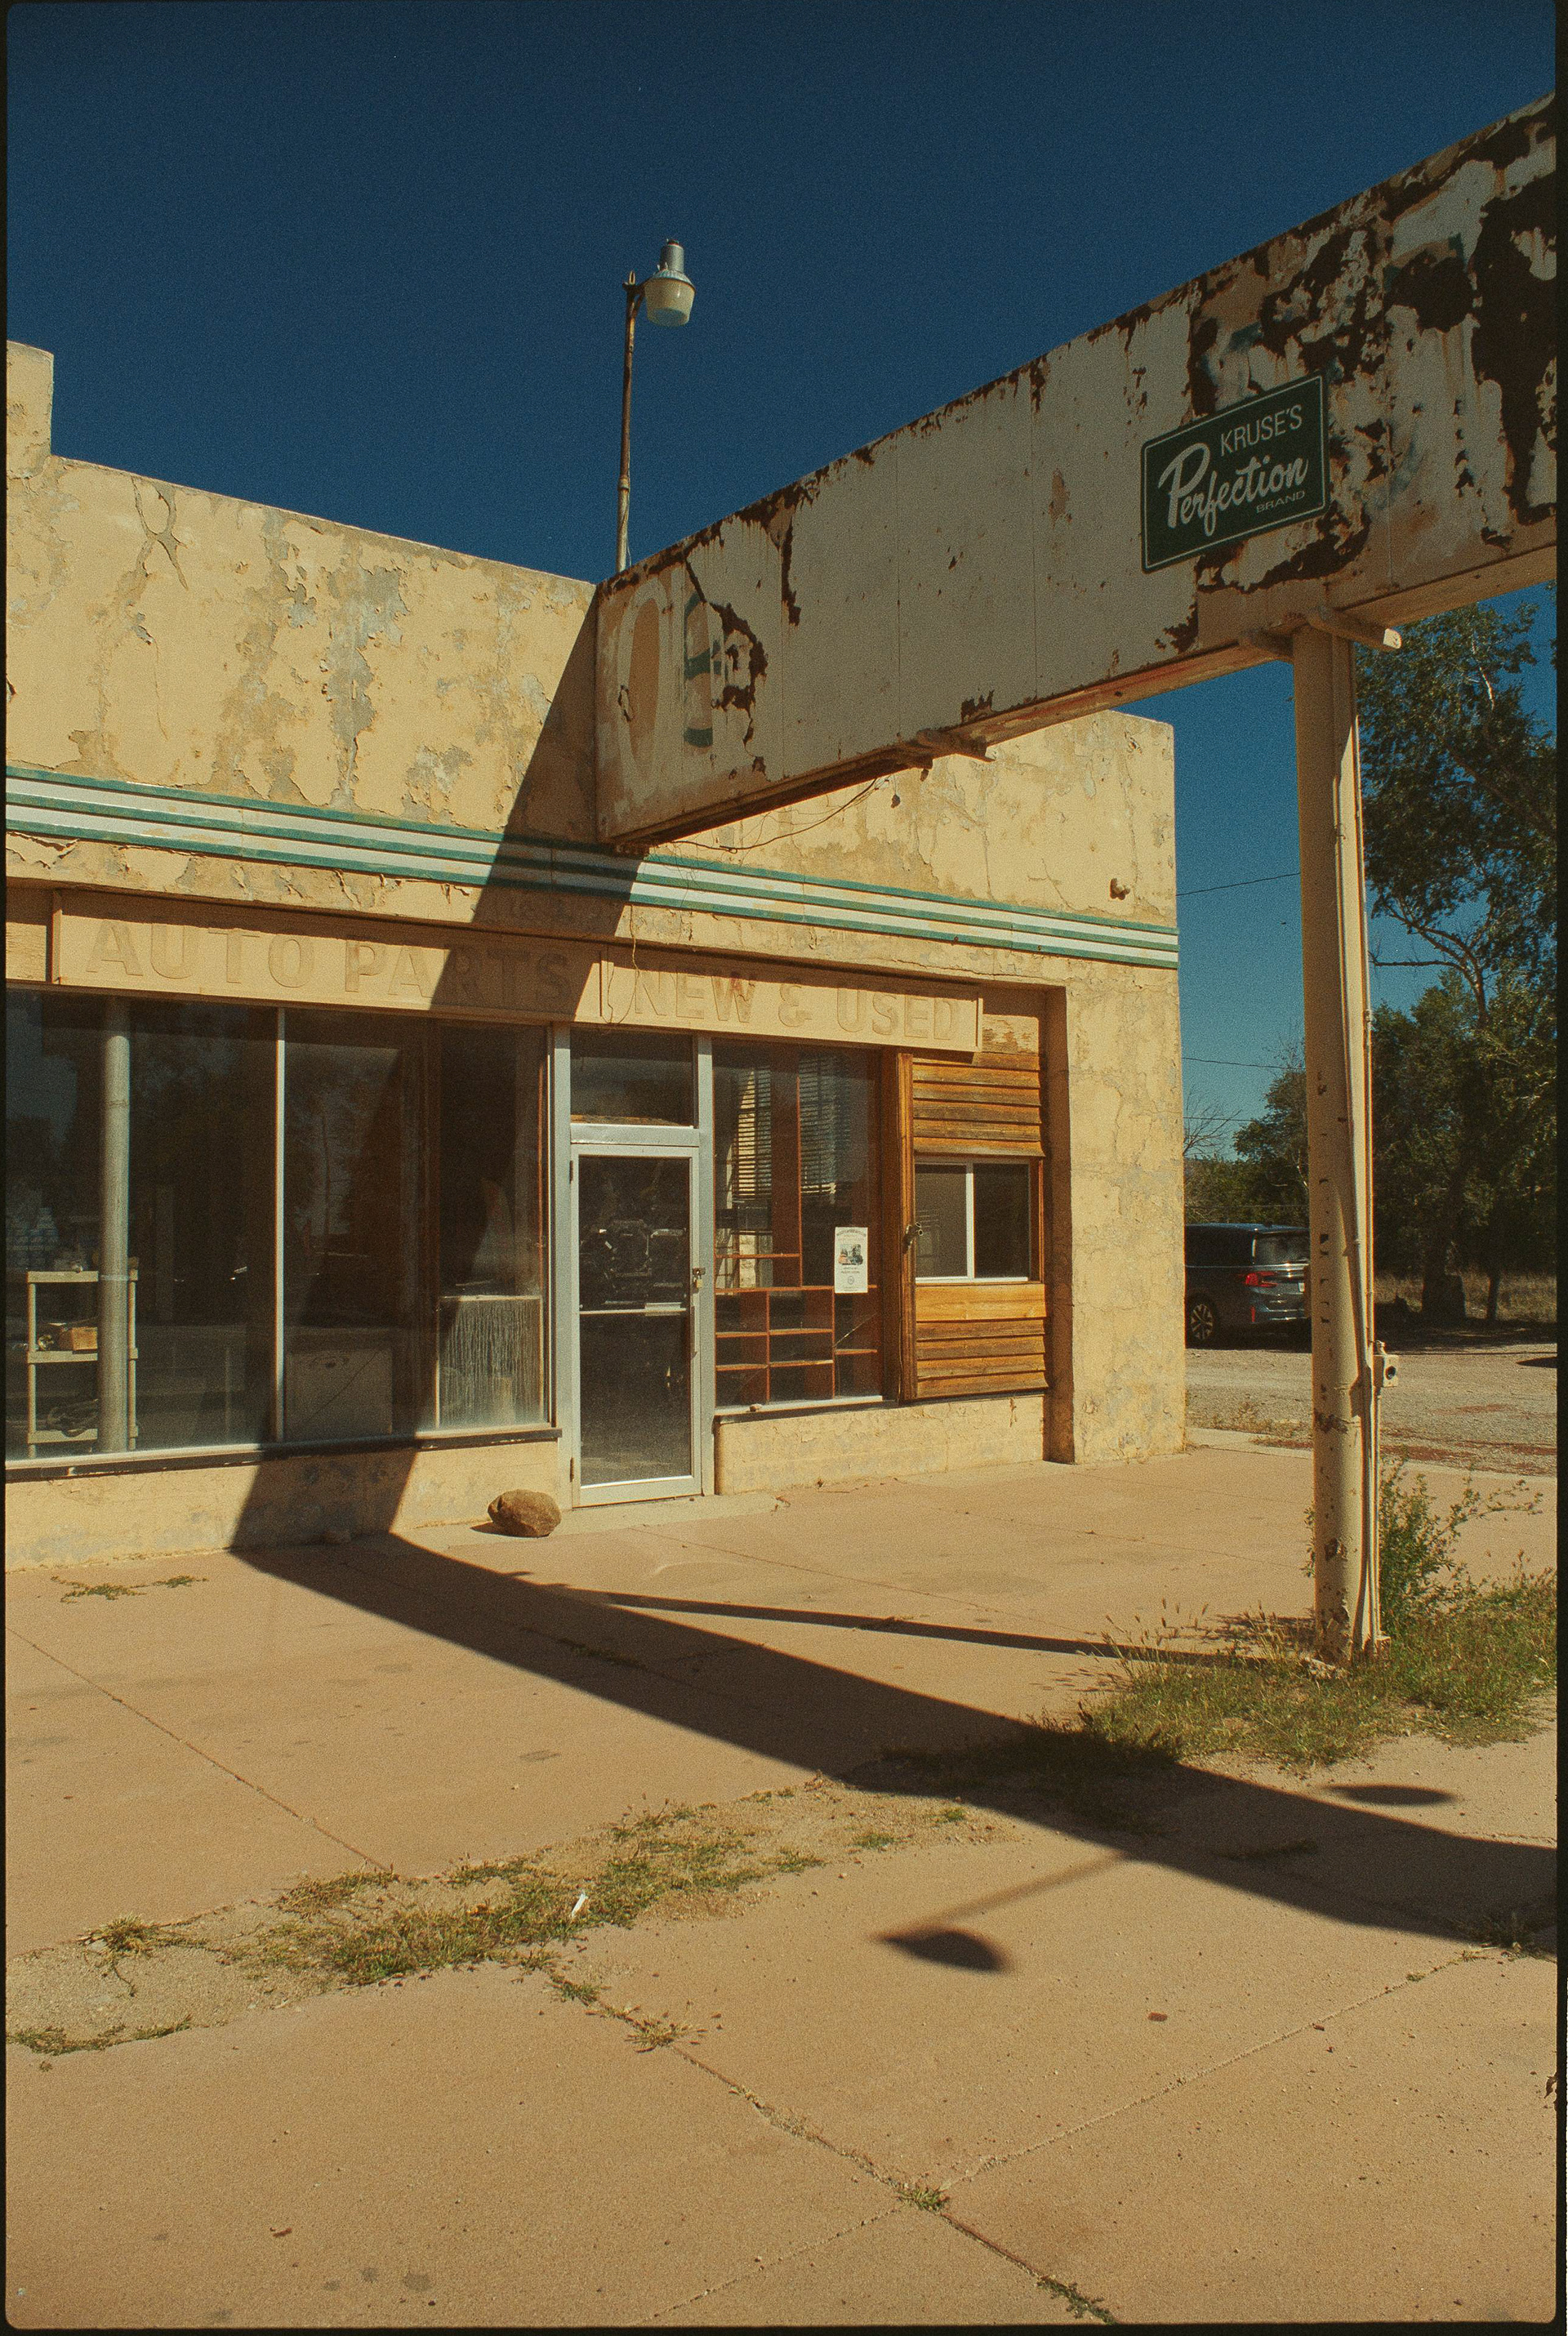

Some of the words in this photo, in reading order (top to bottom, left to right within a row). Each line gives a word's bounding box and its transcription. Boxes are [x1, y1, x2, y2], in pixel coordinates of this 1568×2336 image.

[1220, 404, 1303, 457] KRUSE'S
[1157, 442, 1308, 537] Perfection
[1255, 490, 1305, 514] BRAND
[87, 912, 314, 989] AUTO
[344, 933, 572, 1008] PARTS
[634, 961, 757, 1023] NEW
[778, 974, 813, 1028] &
[835, 979, 960, 1041] USED
